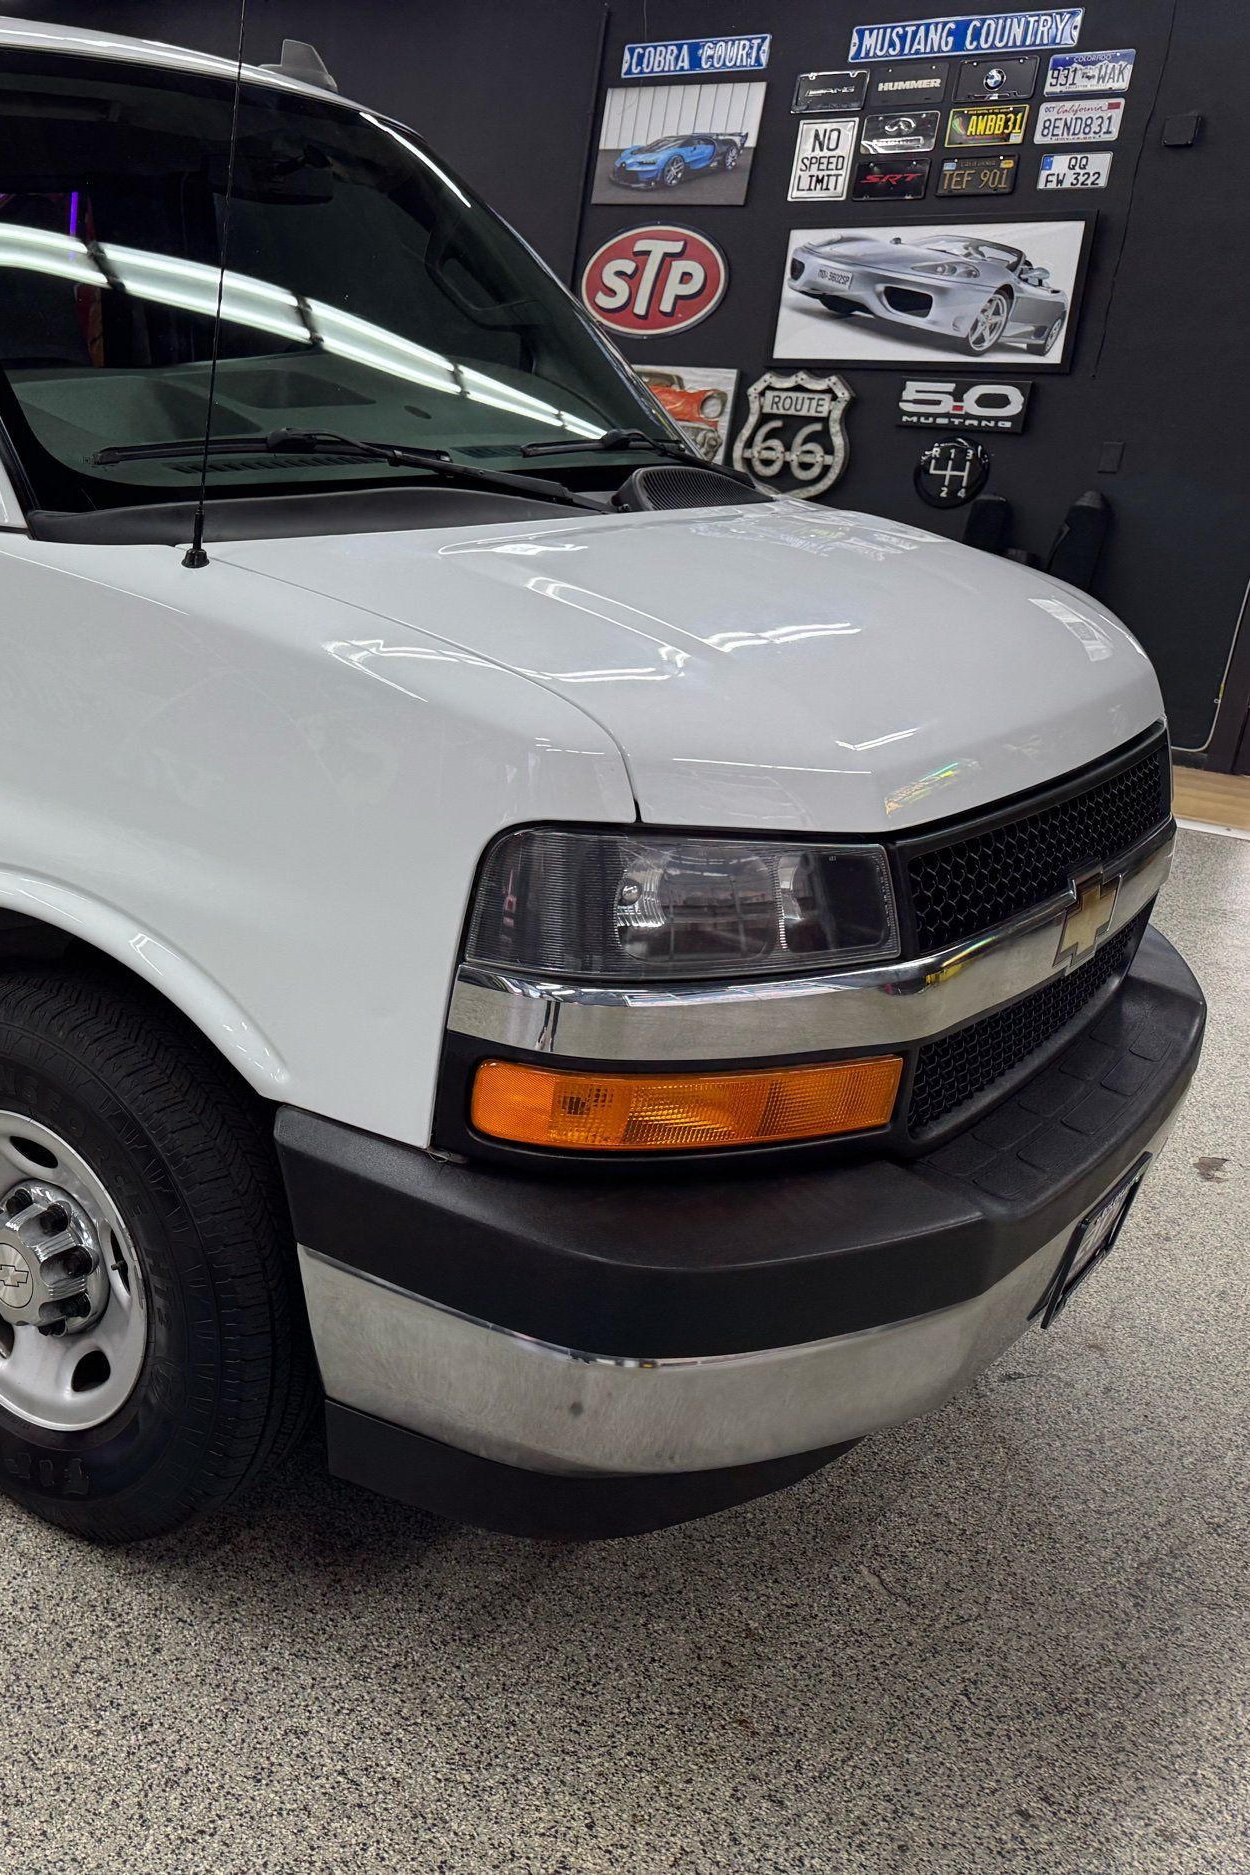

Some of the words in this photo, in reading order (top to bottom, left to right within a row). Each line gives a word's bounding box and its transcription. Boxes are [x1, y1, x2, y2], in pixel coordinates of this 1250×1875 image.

[859, 21, 956, 58] MUSTANG
[964, 11, 1071, 50] COUNTRY
[630, 44, 690, 73] COBRA
[700, 38, 762, 68] COURT
[1073, 54, 1112, 63] COLORADO
[1049, 67, 1078, 87] 931
[1096, 63, 1130, 85] WAK
[877, 78, 941, 92] HUMMER
[1056, 103, 1108, 116] California
[1041, 115, 1113, 138] 8END831
[812, 127, 842, 153] NO
[799, 155, 846, 173] SPEED
[1067, 156, 1089, 171] QQ
[796, 173, 843, 192] LIMIT
[860, 172, 925, 185] SRT
[943, 169, 976, 190] TEF
[978, 169, 1008, 189] 901
[1043, 172, 1067, 187] FW
[1070, 171, 1101, 187] 322
[594, 239, 706, 317] STP
[770, 395, 826, 414] ROUTE
[898, 381, 1025, 417] 5.0
[901, 415, 1013, 429] MUSTANG
[751, 419, 825, 481] 66
[932, 447, 940, 458] R
[950, 449, 956, 459] 1
[965, 449, 974, 460] 3
[939, 487, 948, 497] 2
[957, 487, 967, 497] 4
